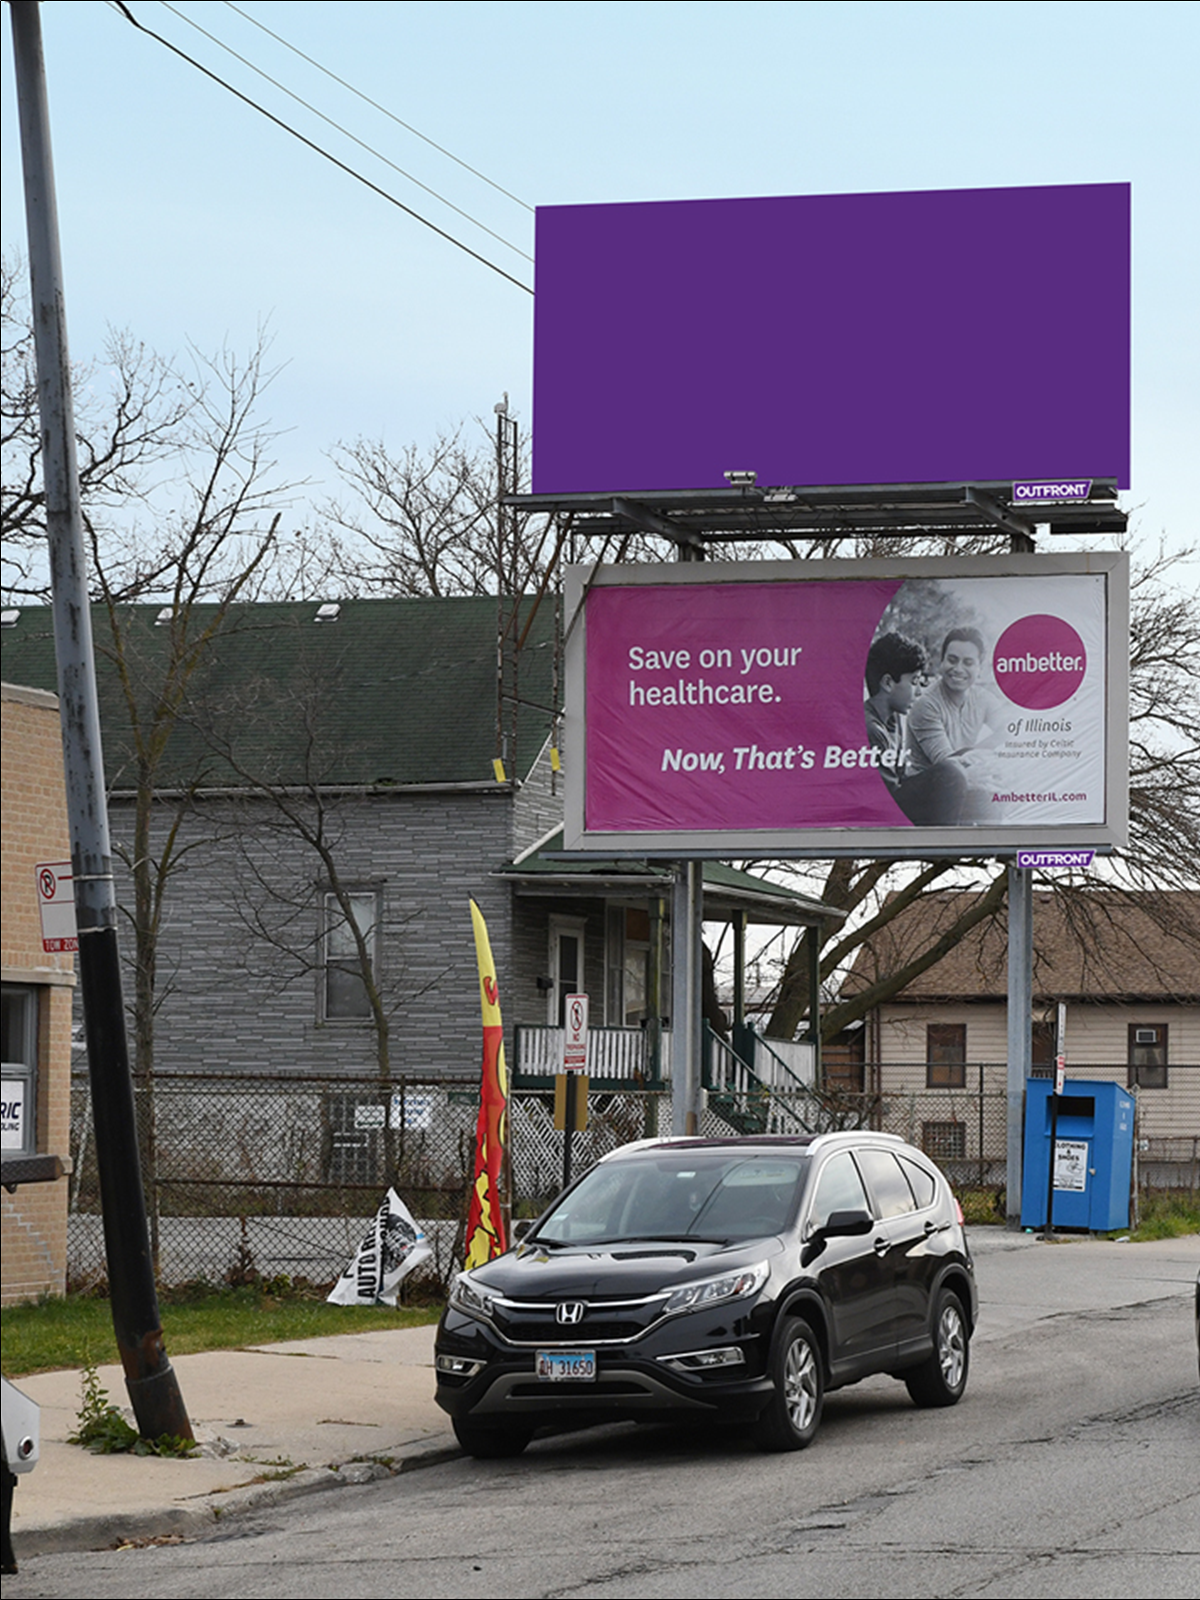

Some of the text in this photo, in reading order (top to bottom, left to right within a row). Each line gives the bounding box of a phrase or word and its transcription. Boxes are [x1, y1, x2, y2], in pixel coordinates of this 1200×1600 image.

[1016, 483, 1087, 498] OUTFRONT
[629, 646, 802, 674] Save on your
[996, 652, 1083, 673] ambetter.
[629, 679, 782, 706] healthcare.
[1007, 718, 1072, 736] of Illinois
[1038, 739, 1048, 749] by
[661, 744, 912, 774] Now, That’s Better.
[1042, 750, 1082, 759] Company
[992, 791, 1087, 803] AmbetterIL.com
[1020, 853, 1090, 866] OUTFRONT
[1055, 1142, 1086, 1150] LOTHING
[357, 1253, 377, 1298] AUTO
[559, 1360, 594, 1376] 31650
